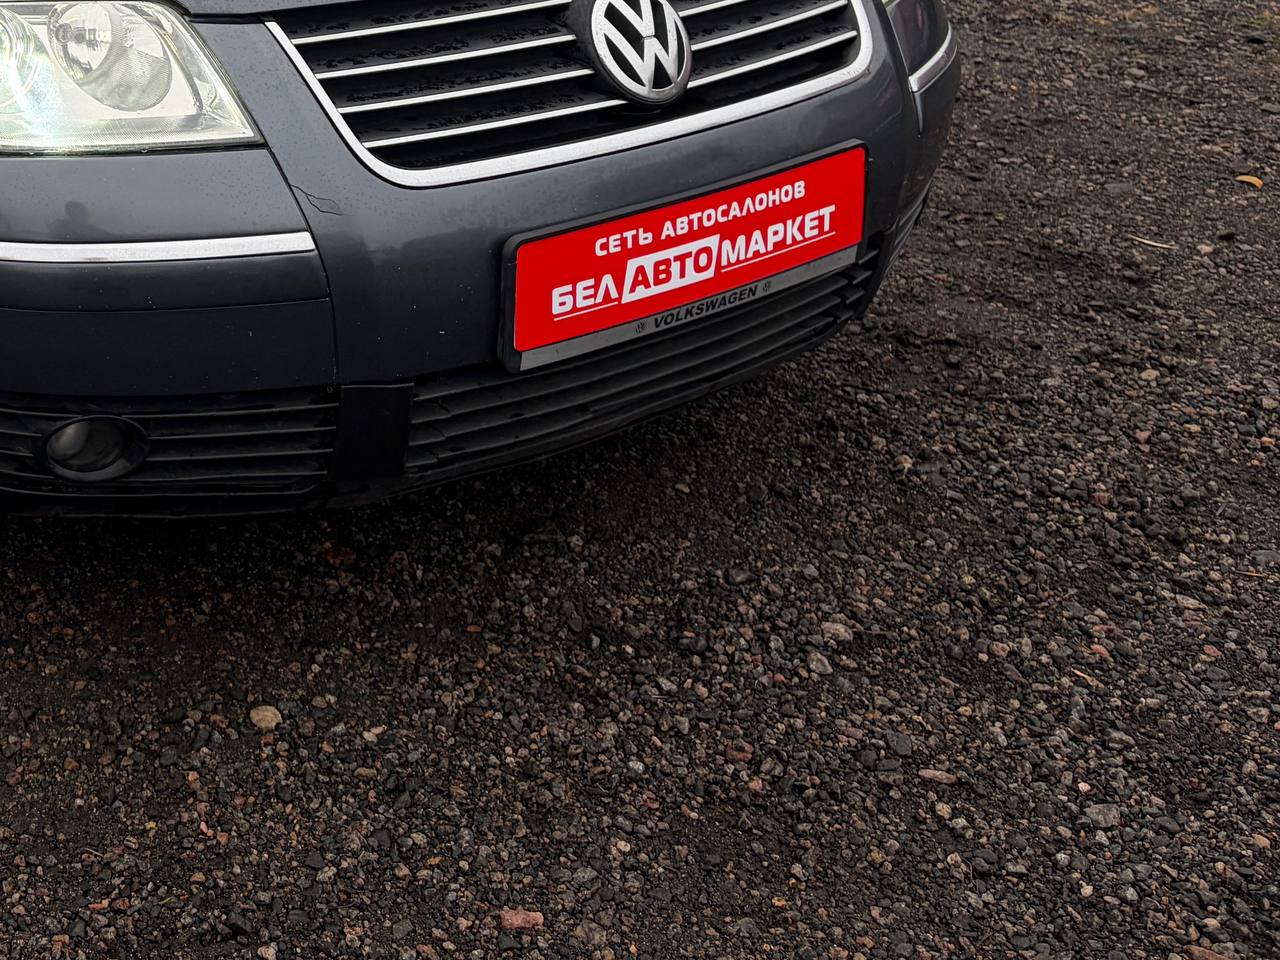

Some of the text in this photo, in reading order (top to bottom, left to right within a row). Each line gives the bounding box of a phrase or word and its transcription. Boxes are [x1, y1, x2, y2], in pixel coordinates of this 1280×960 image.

[595, 180, 806, 257] СЕТЬ АВТОСАЛОНОВ
[653, 286, 758, 328] VOLKSWAGEN
